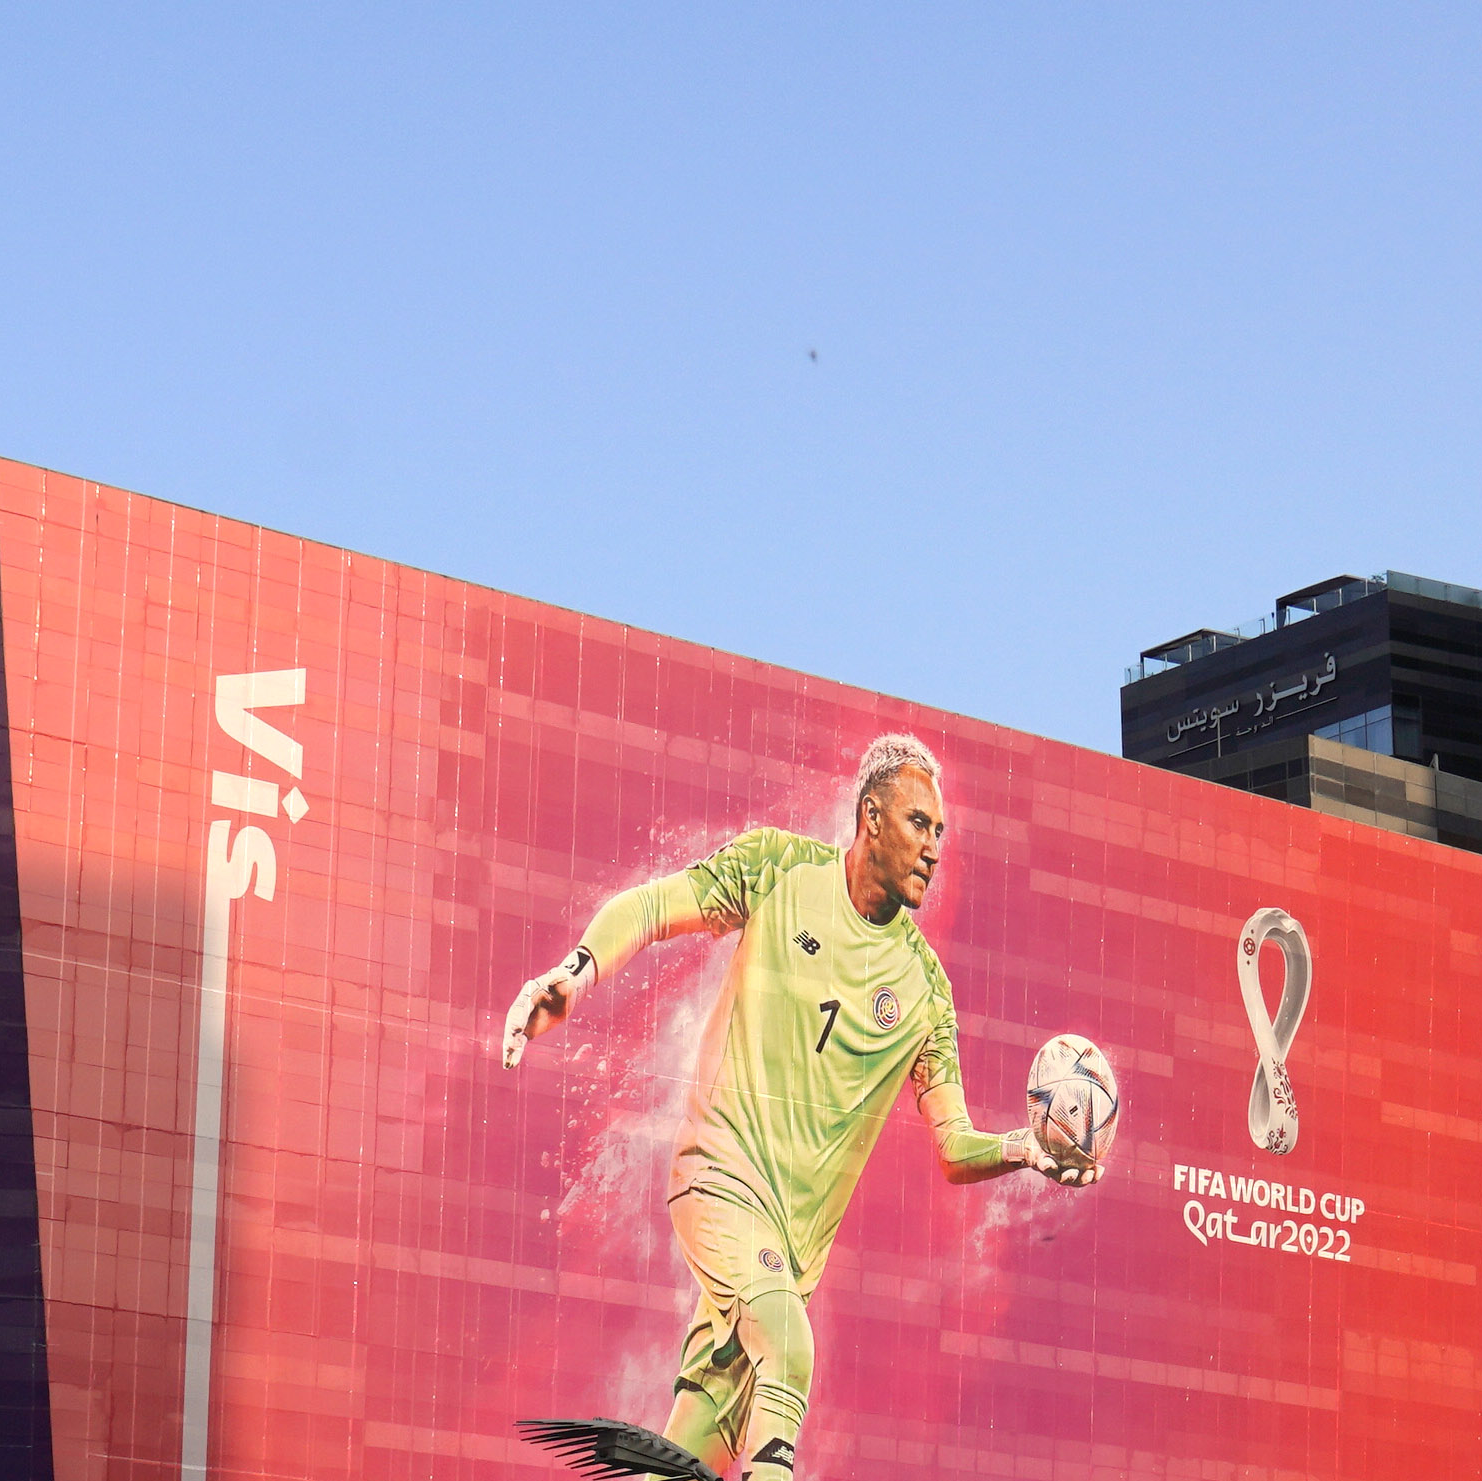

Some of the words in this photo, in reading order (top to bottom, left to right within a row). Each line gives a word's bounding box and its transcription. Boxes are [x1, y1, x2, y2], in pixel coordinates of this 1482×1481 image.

[1253, 651, 1337, 717] فريزر
[1167, 699, 1240, 743] سويتس
[1173, 1163, 1227, 1200] FIFA
[1229, 1174, 1316, 1215] WORLD
[1320, 1192, 1366, 1224] CUP
